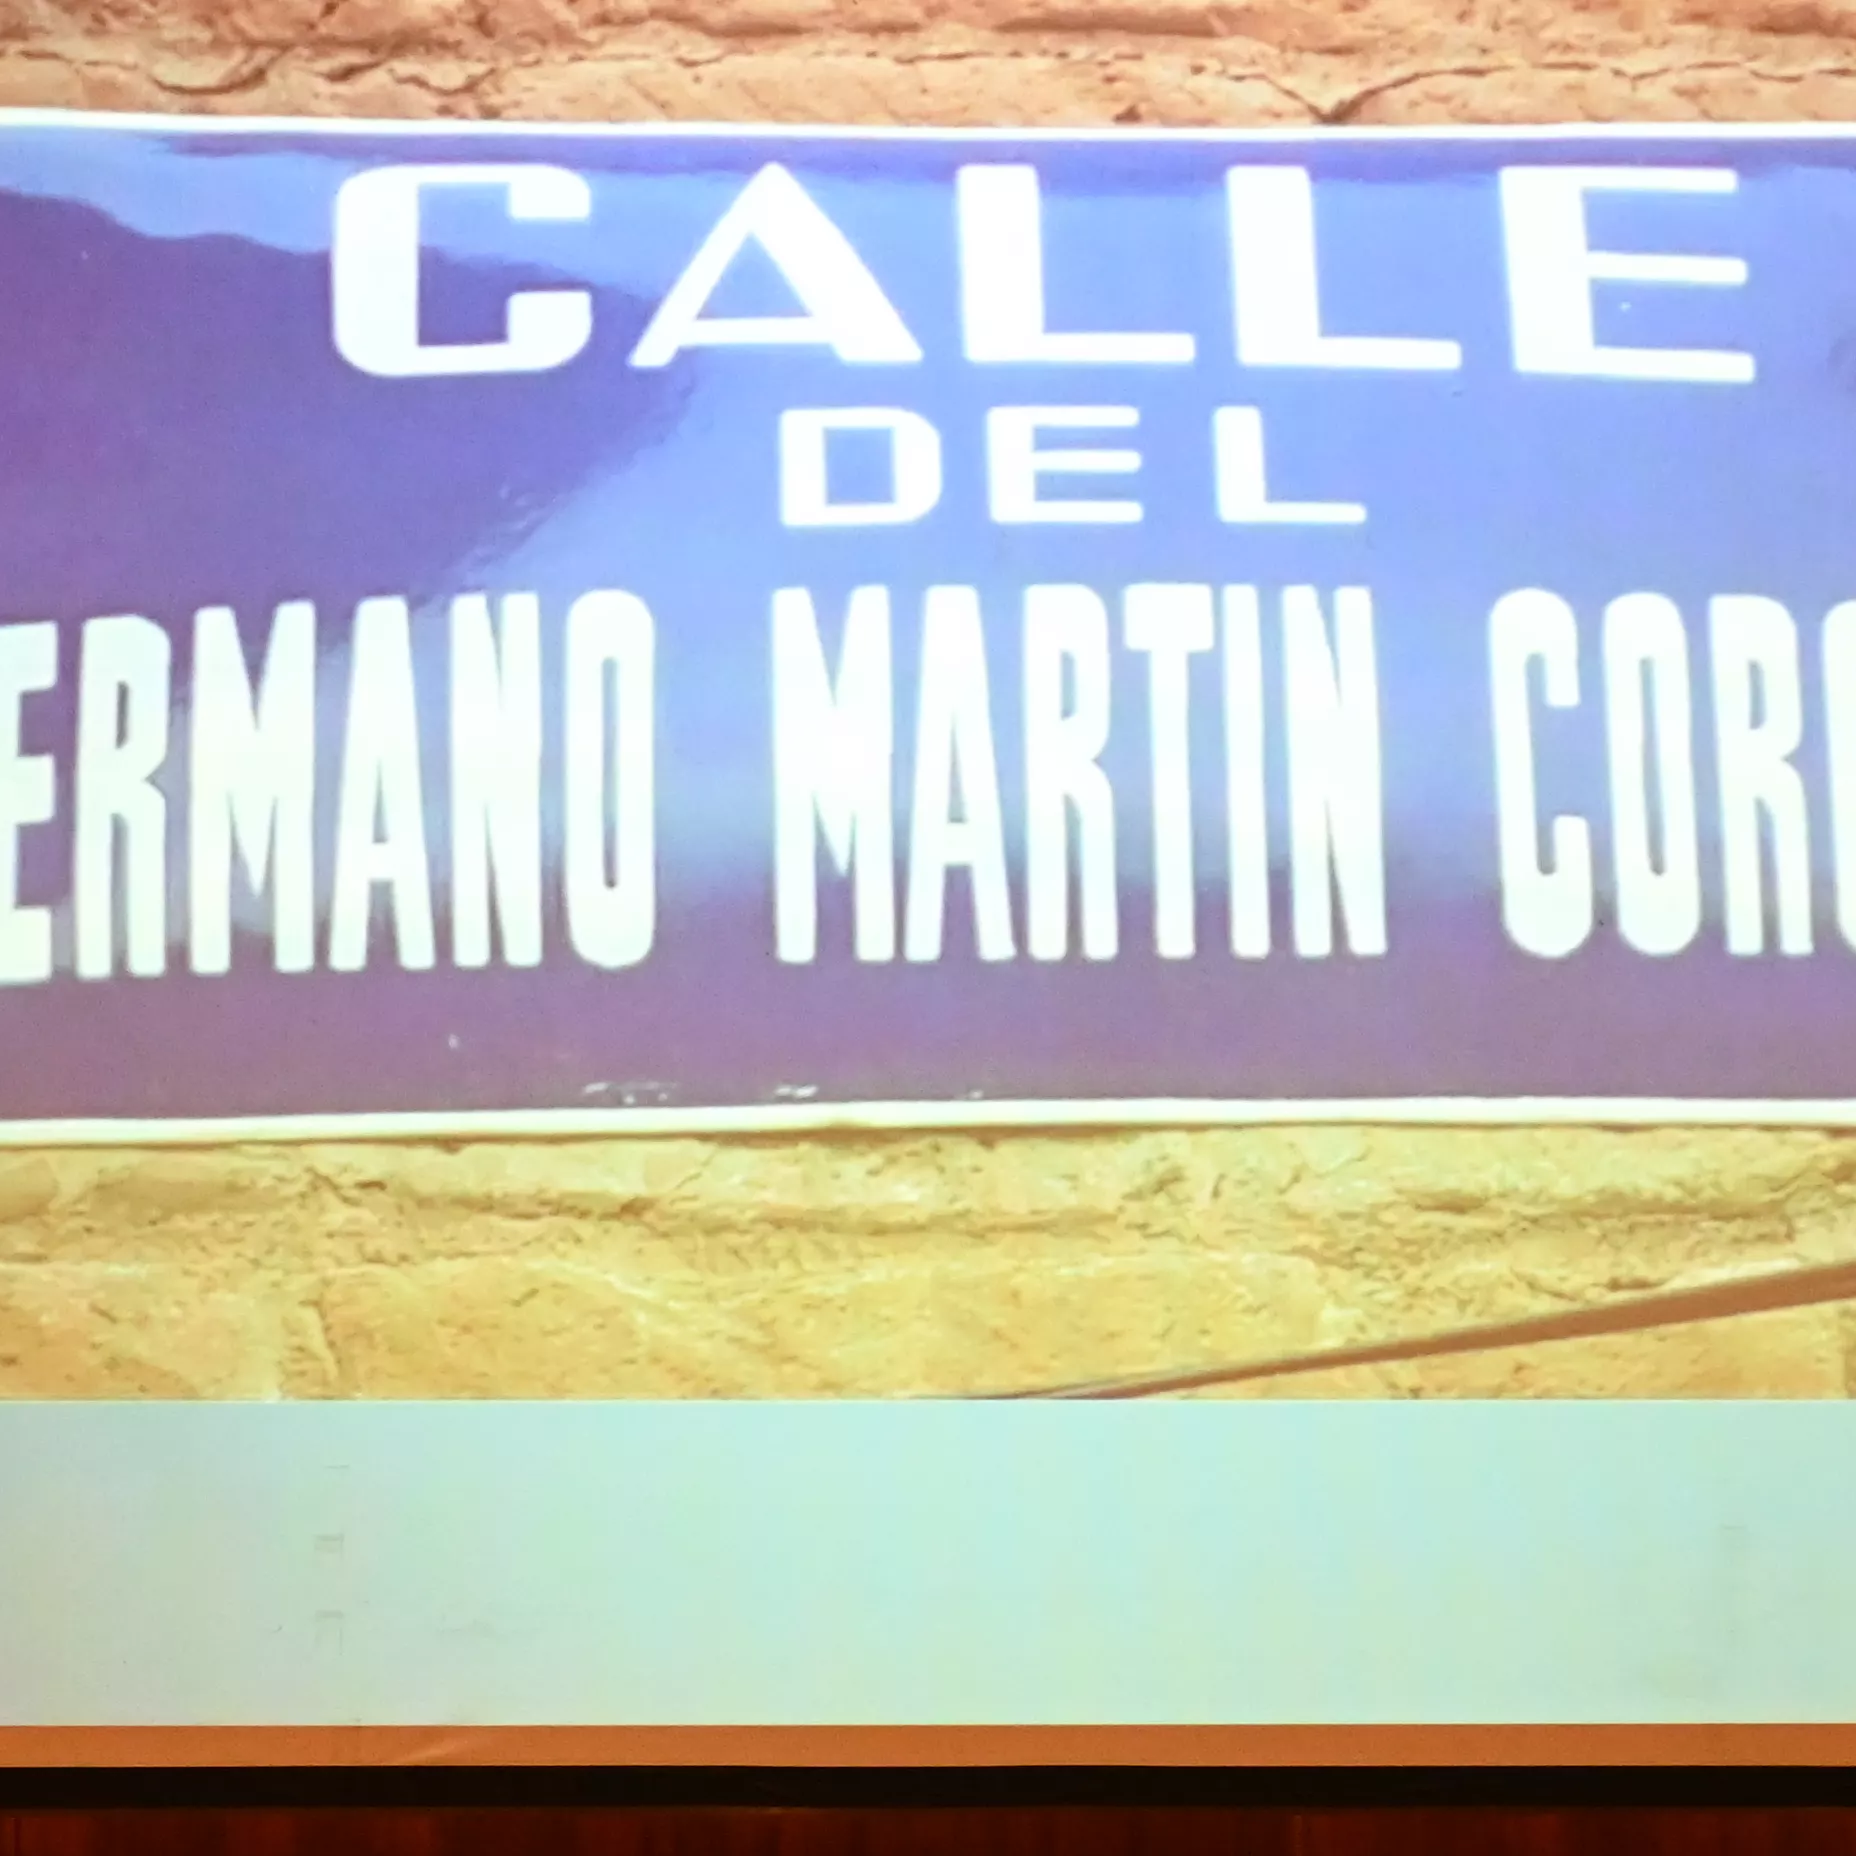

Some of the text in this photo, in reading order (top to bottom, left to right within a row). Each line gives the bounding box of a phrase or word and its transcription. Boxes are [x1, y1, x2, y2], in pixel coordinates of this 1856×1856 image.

[331, 161, 1755, 382] CALLE
[778, 405, 1366, 527] DEL
[771, 583, 1388, 964] MARTIN
